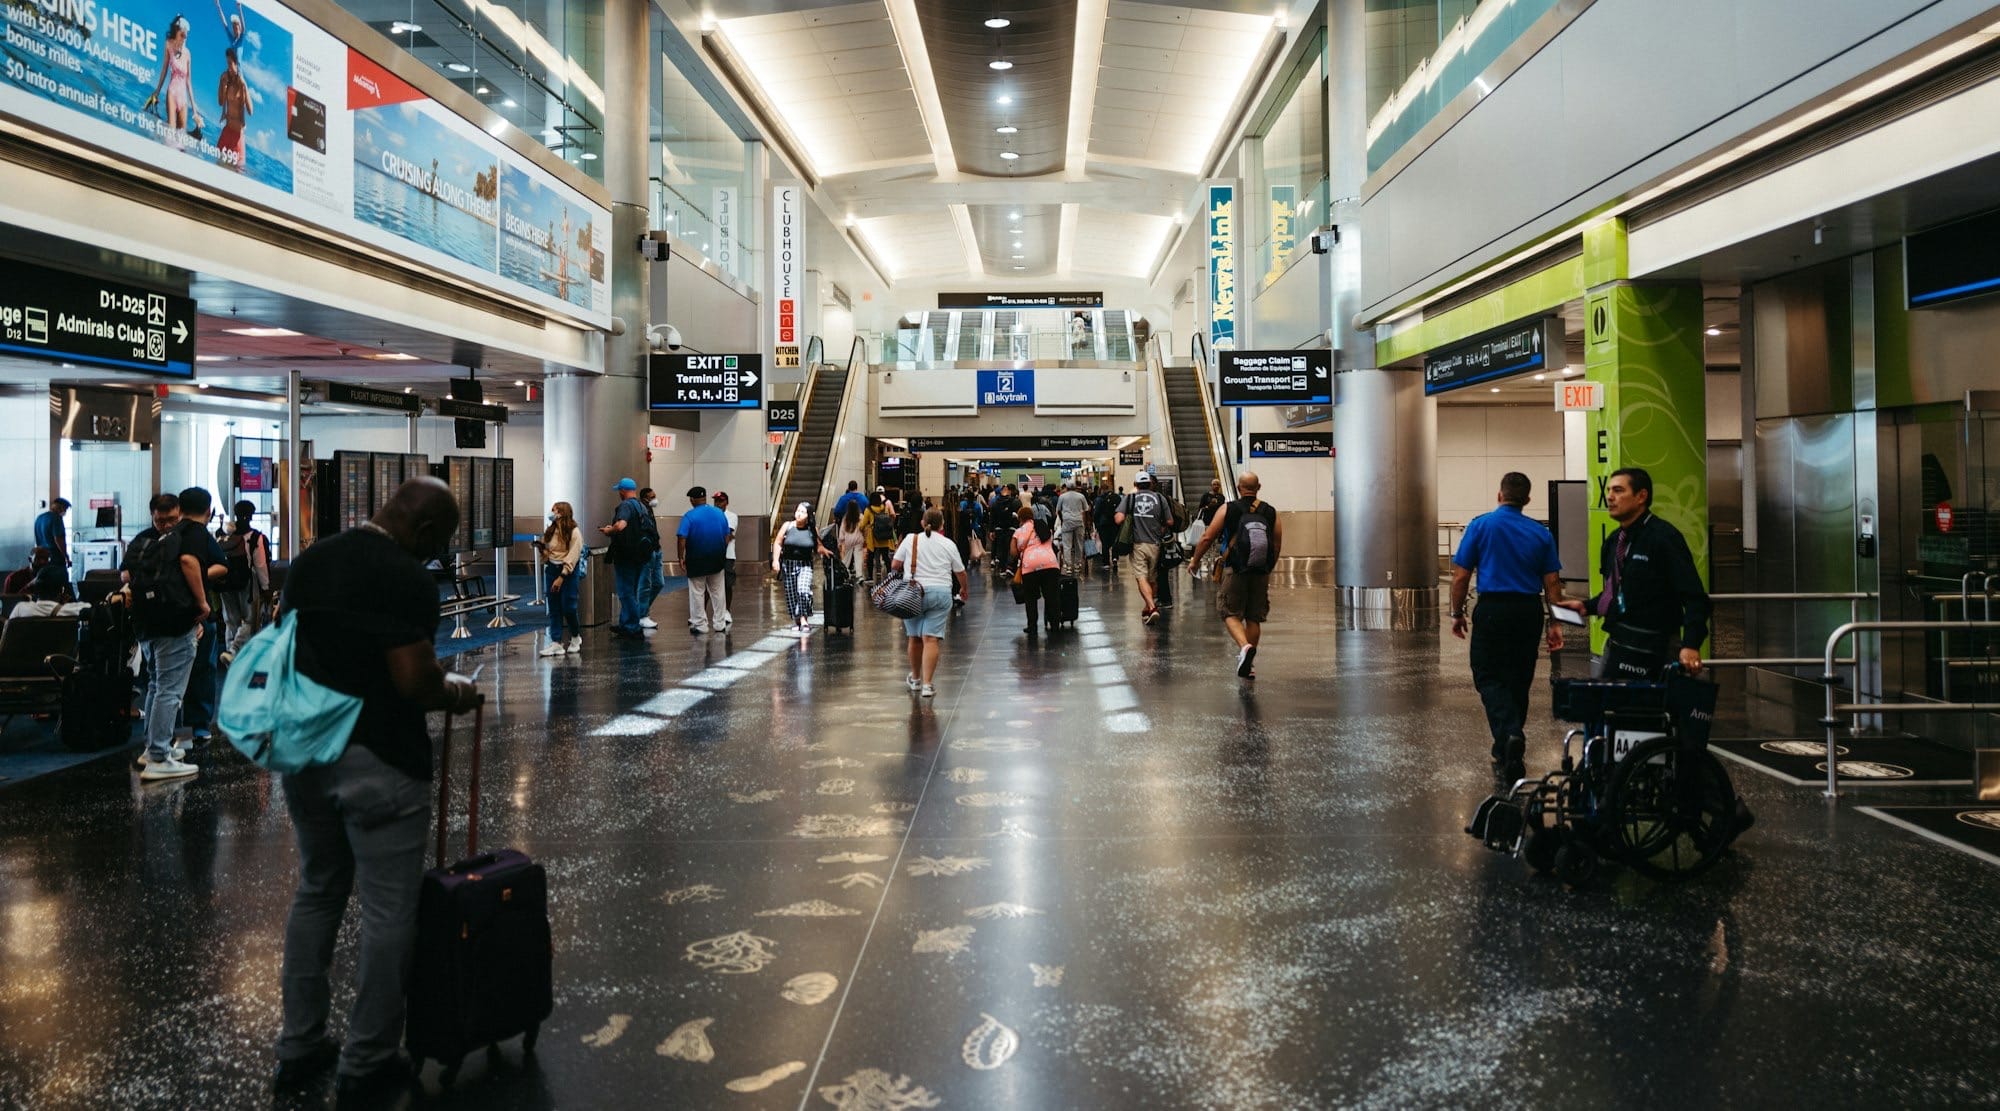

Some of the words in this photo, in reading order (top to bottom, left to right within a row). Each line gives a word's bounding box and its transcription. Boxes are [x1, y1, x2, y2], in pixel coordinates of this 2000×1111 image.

[7, 4, 37, 29] with
[39, 16, 82, 49] 50,000
[102, 7, 158, 62] HERE
[6, 24, 46, 57] bonus
[48, 46, 83, 73] miles.
[6, 57, 24, 80] $0
[26, 63, 57, 93] intro
[58, 84, 98, 110] annual
[100, 95, 119, 119] fee
[120, 103, 136, 125] for
[138, 113, 156, 133] the
[156, 118, 177, 140] first
[177, 129, 200, 152] year,
[200, 138, 220, 160] then
[382, 150, 432, 193] CRUISING
[432, 175, 464, 209] ALONG
[465, 192, 492, 219] THERE
[505, 211, 531, 241] BEGINS
[531, 223, 549, 249] HERE
[782, 190, 792, 298] CLUBHOUSE
[100, 290, 146, 316] D1-D25
[0, 306, 22, 327] ge
[56, 312, 114, 339] Admirals
[117, 323, 145, 344] Club
[781, 302, 793, 342] one
[6, 327, 22, 341] D12
[1511, 334, 1522, 349] EXIT
[775, 346, 799, 355] KITCHEN
[686, 356, 722, 370] EXIT
[775, 357, 781, 366] &
[786, 357, 799, 366] BAR
[1233, 358, 1267, 366] Baggage
[1268, 357, 1291, 365] Claim
[676, 374, 722, 384] Terminal
[1001, 378, 1011, 391] 2
[1224, 376, 1253, 384] Ground
[1254, 376, 1291, 384] Transport
[677, 390, 687, 401] F,
[688, 390, 700, 401] G,
[702, 390, 714, 401] H,
[715, 390, 722, 399] J
[995, 393, 1028, 404] skytrain
[1564, 386, 1593, 407] EXIT
[771, 409, 795, 420] D25
[654, 435, 672, 448] EXIT
[1619, 661, 1648, 677] envoy
